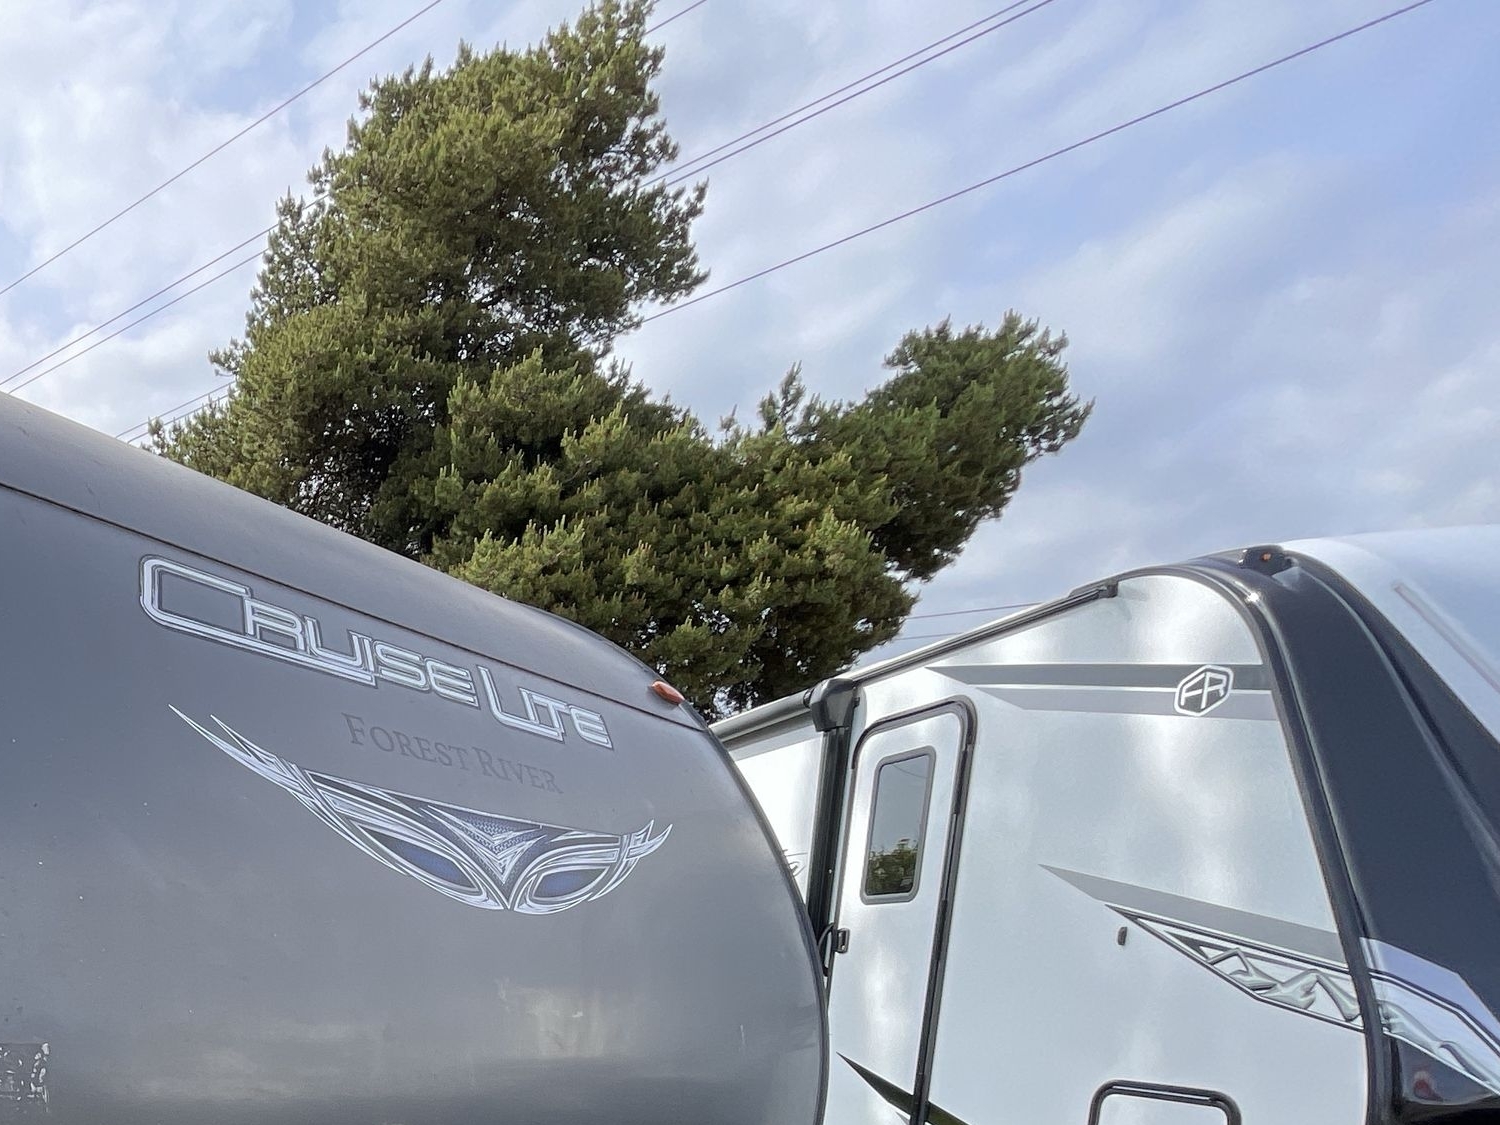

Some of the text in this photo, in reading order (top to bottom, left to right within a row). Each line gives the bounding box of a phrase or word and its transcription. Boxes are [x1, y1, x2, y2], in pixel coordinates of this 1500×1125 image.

[138, 554, 615, 750] CRUISE LITE
[341, 711, 564, 794] FOREST RIVER
